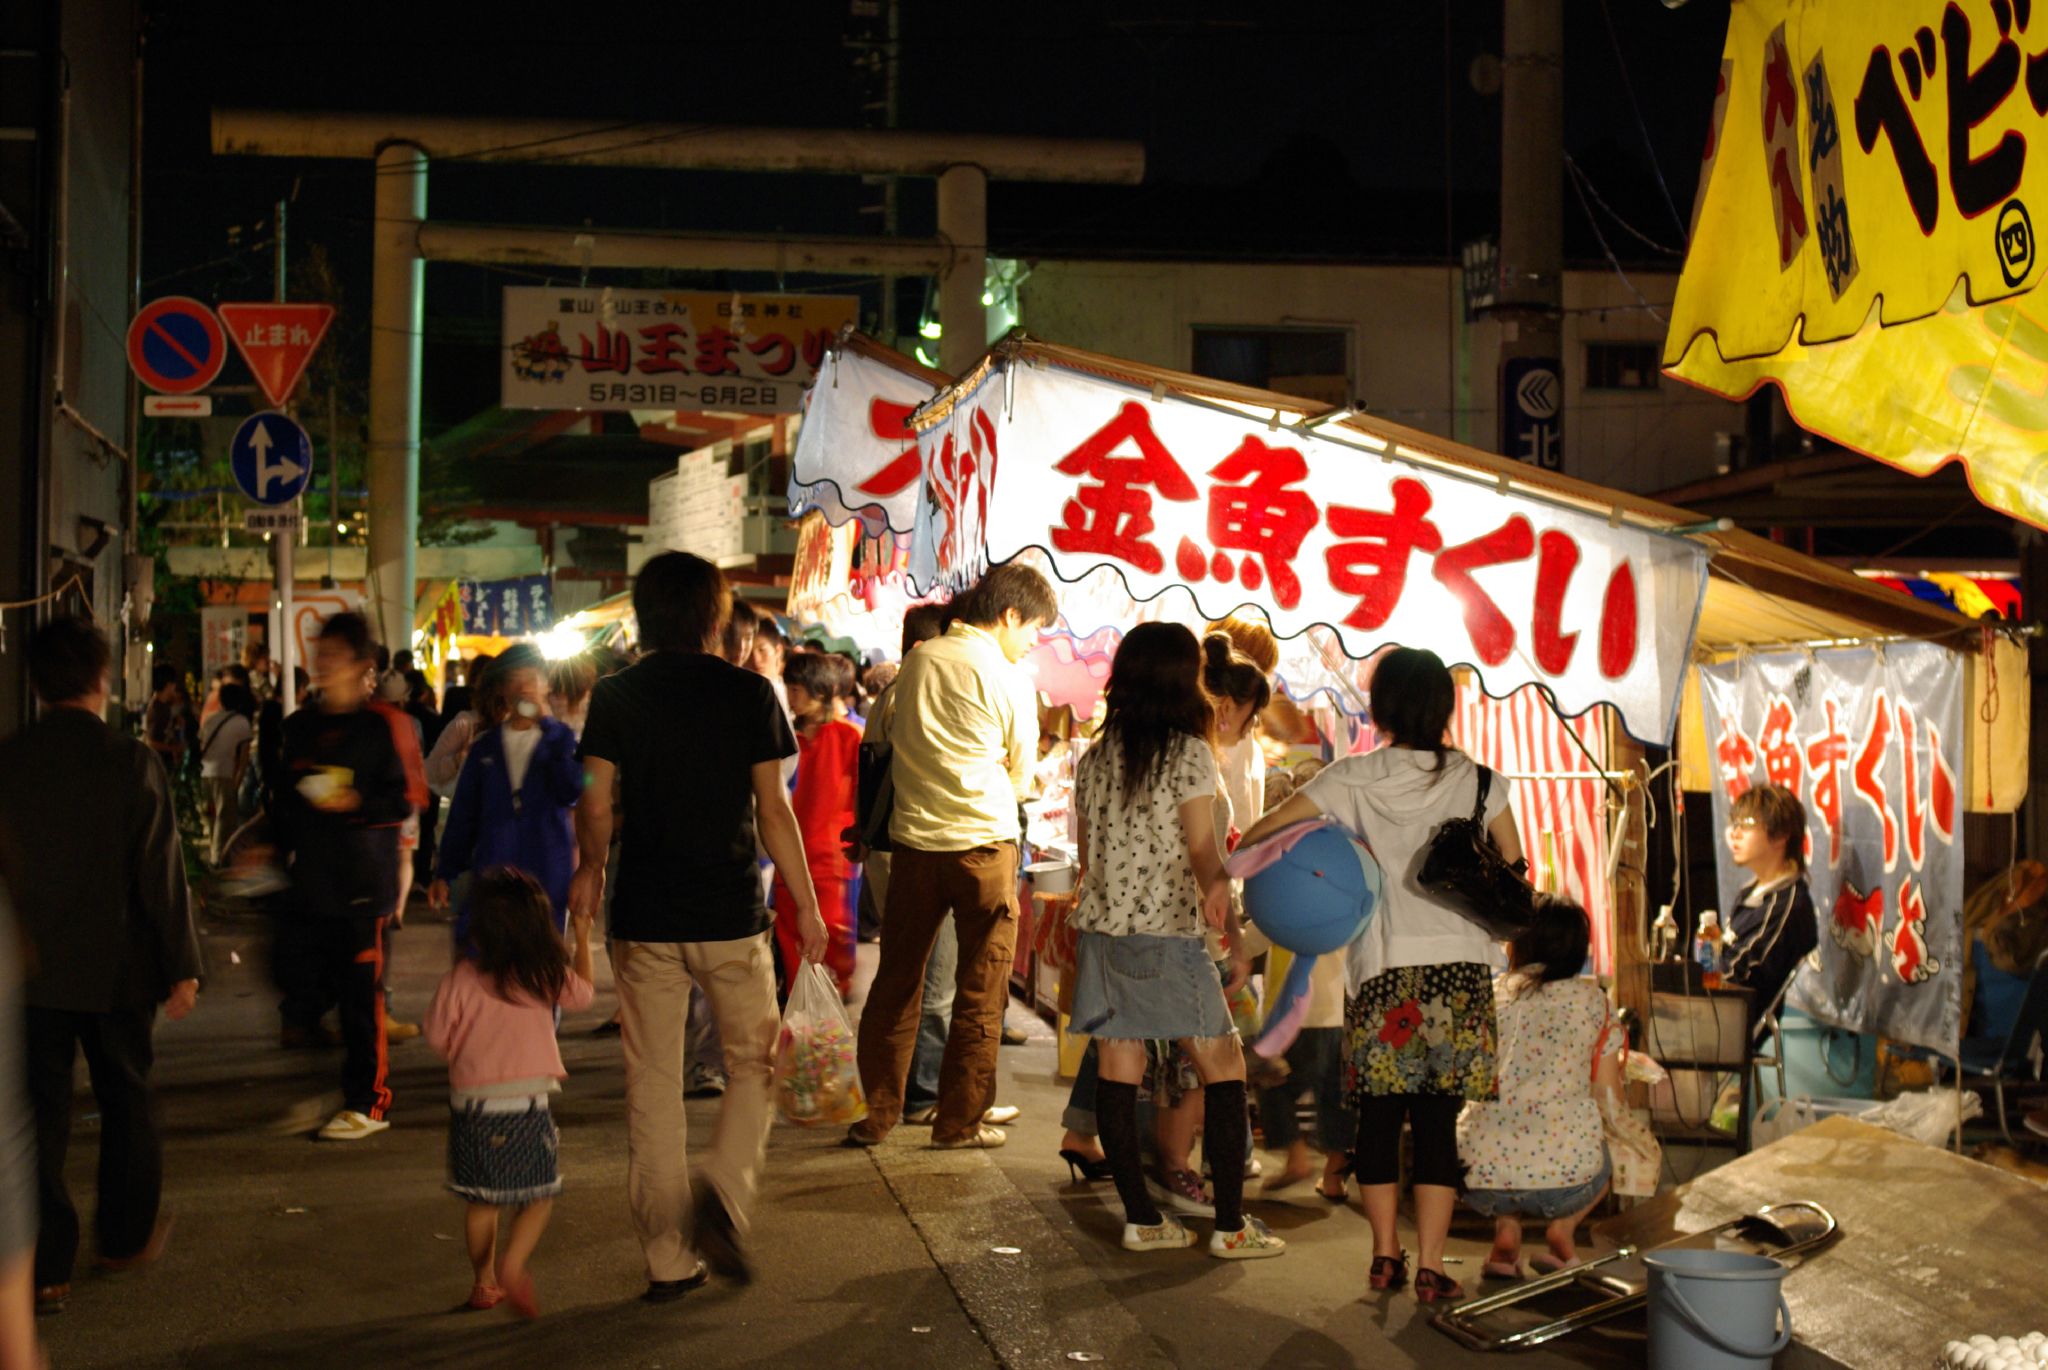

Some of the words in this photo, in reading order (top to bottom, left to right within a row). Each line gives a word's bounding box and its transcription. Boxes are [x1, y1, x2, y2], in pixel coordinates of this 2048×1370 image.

[1808, 63, 1851, 296] 名物
[1854, 0, 2048, 237] ベビ
[244, 323, 312, 347] 止まれ
[579, 320, 836, 377] 山王まつり
[1519, 423, 1560, 468] 北
[1050, 399, 1640, 682] 金魚すくい
